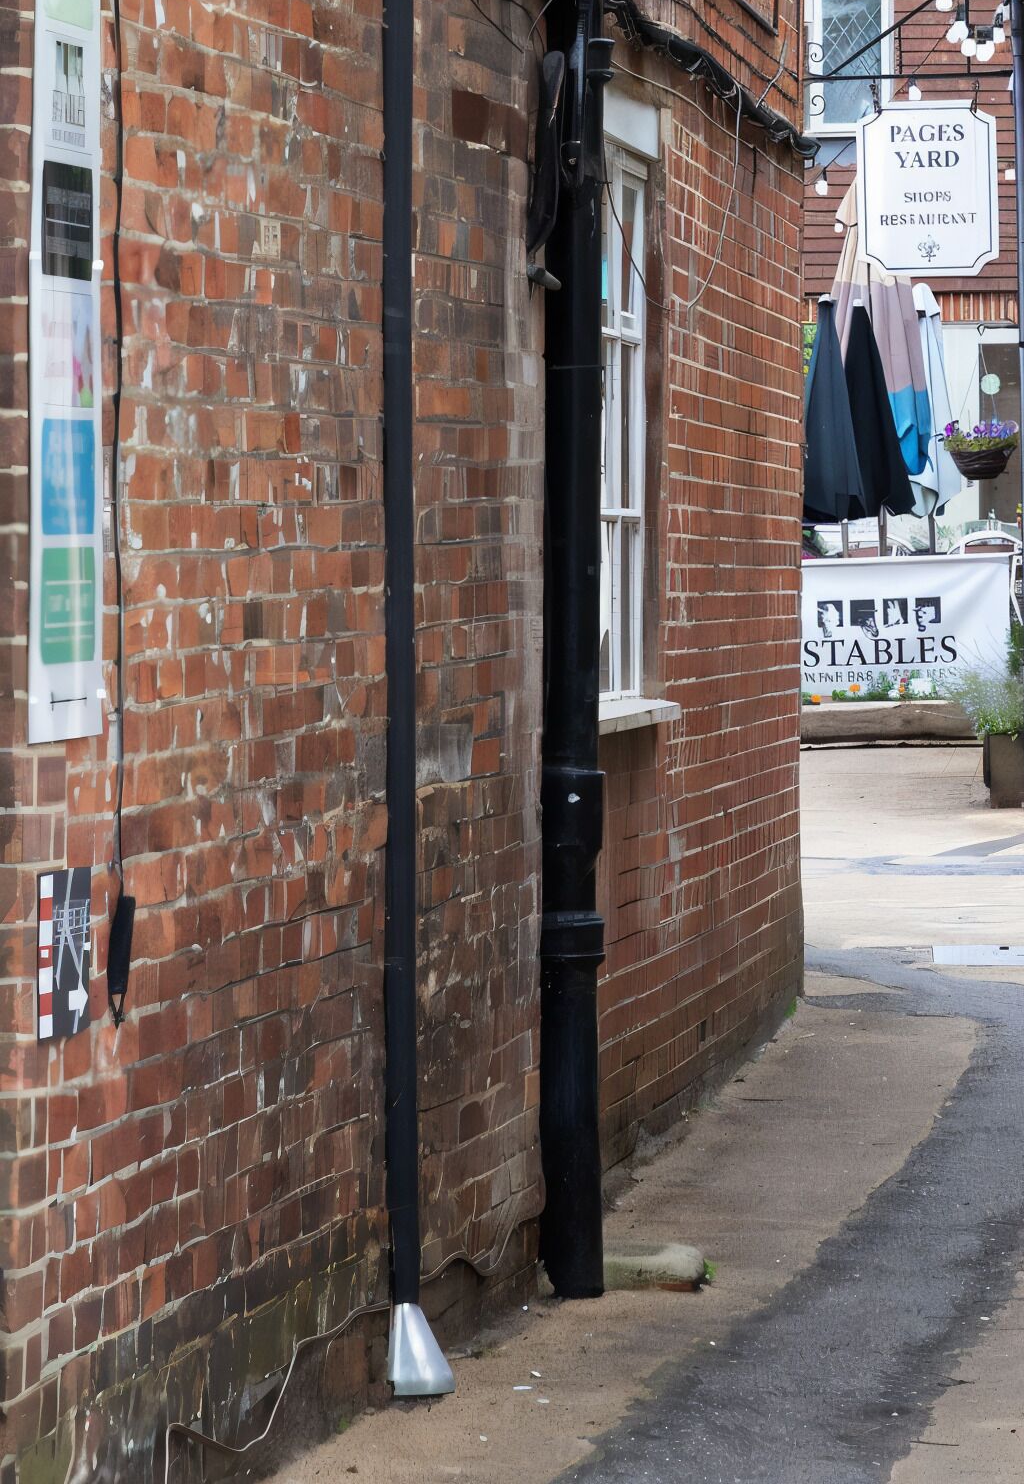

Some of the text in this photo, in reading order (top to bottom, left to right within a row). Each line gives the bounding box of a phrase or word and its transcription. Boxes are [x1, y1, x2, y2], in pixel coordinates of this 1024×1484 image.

[890, 123, 965, 143] PAGES
[894, 150, 960, 168] YARD
[803, 635, 957, 668] STABLES
